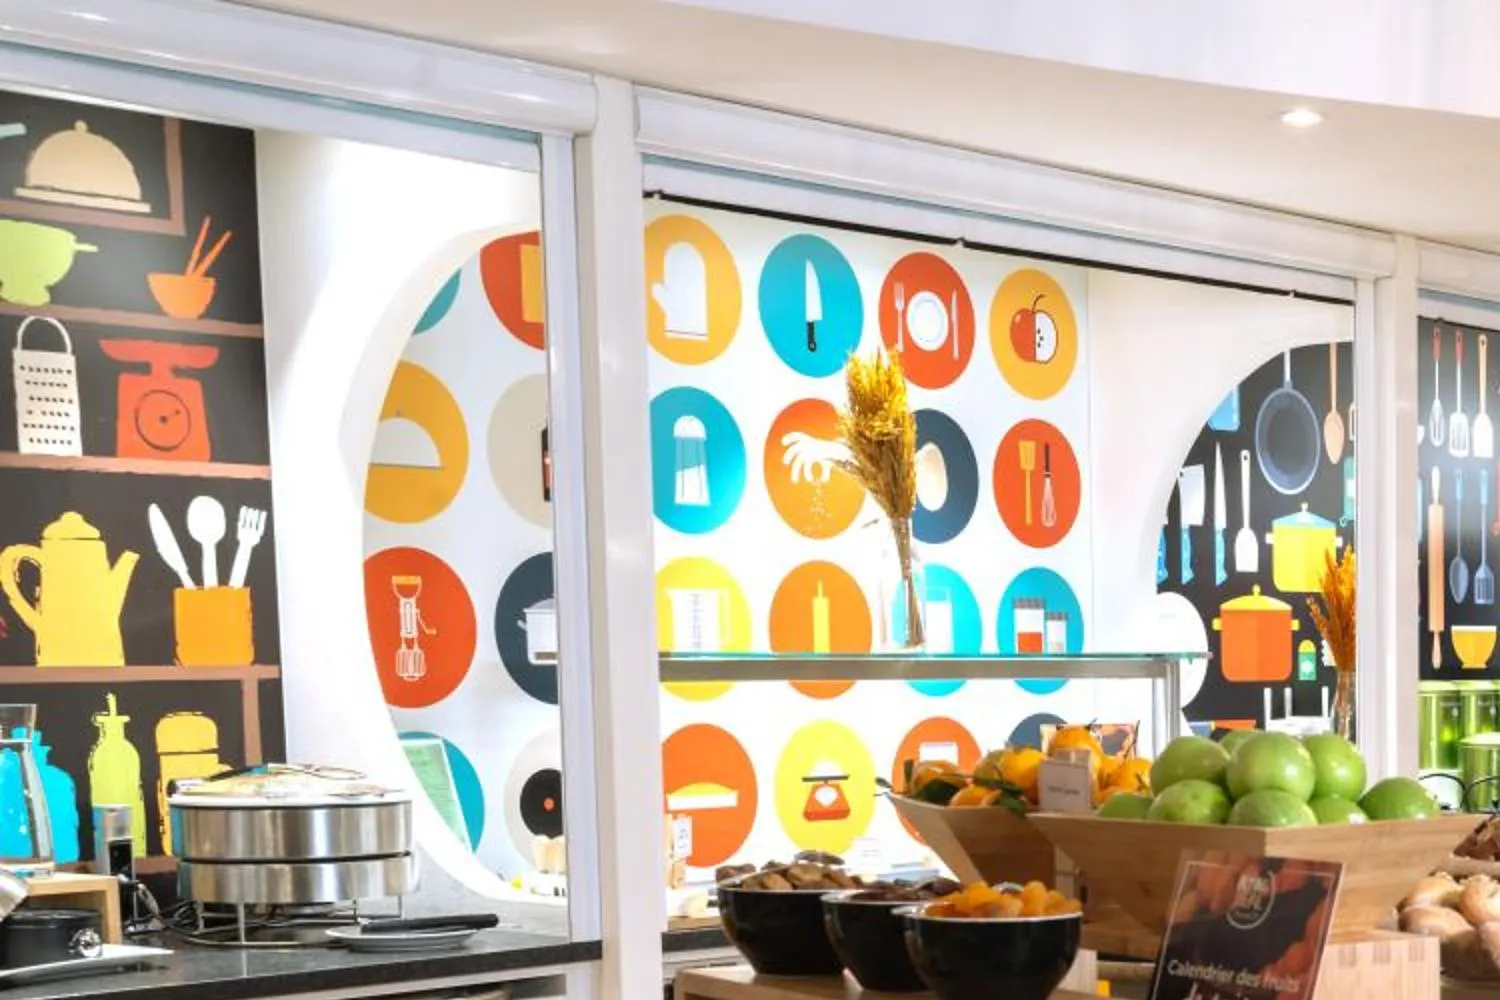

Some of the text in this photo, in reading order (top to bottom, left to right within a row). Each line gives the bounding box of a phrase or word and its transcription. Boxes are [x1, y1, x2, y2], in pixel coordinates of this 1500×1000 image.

[1168, 959, 1300, 993] Calendrier des fruits
